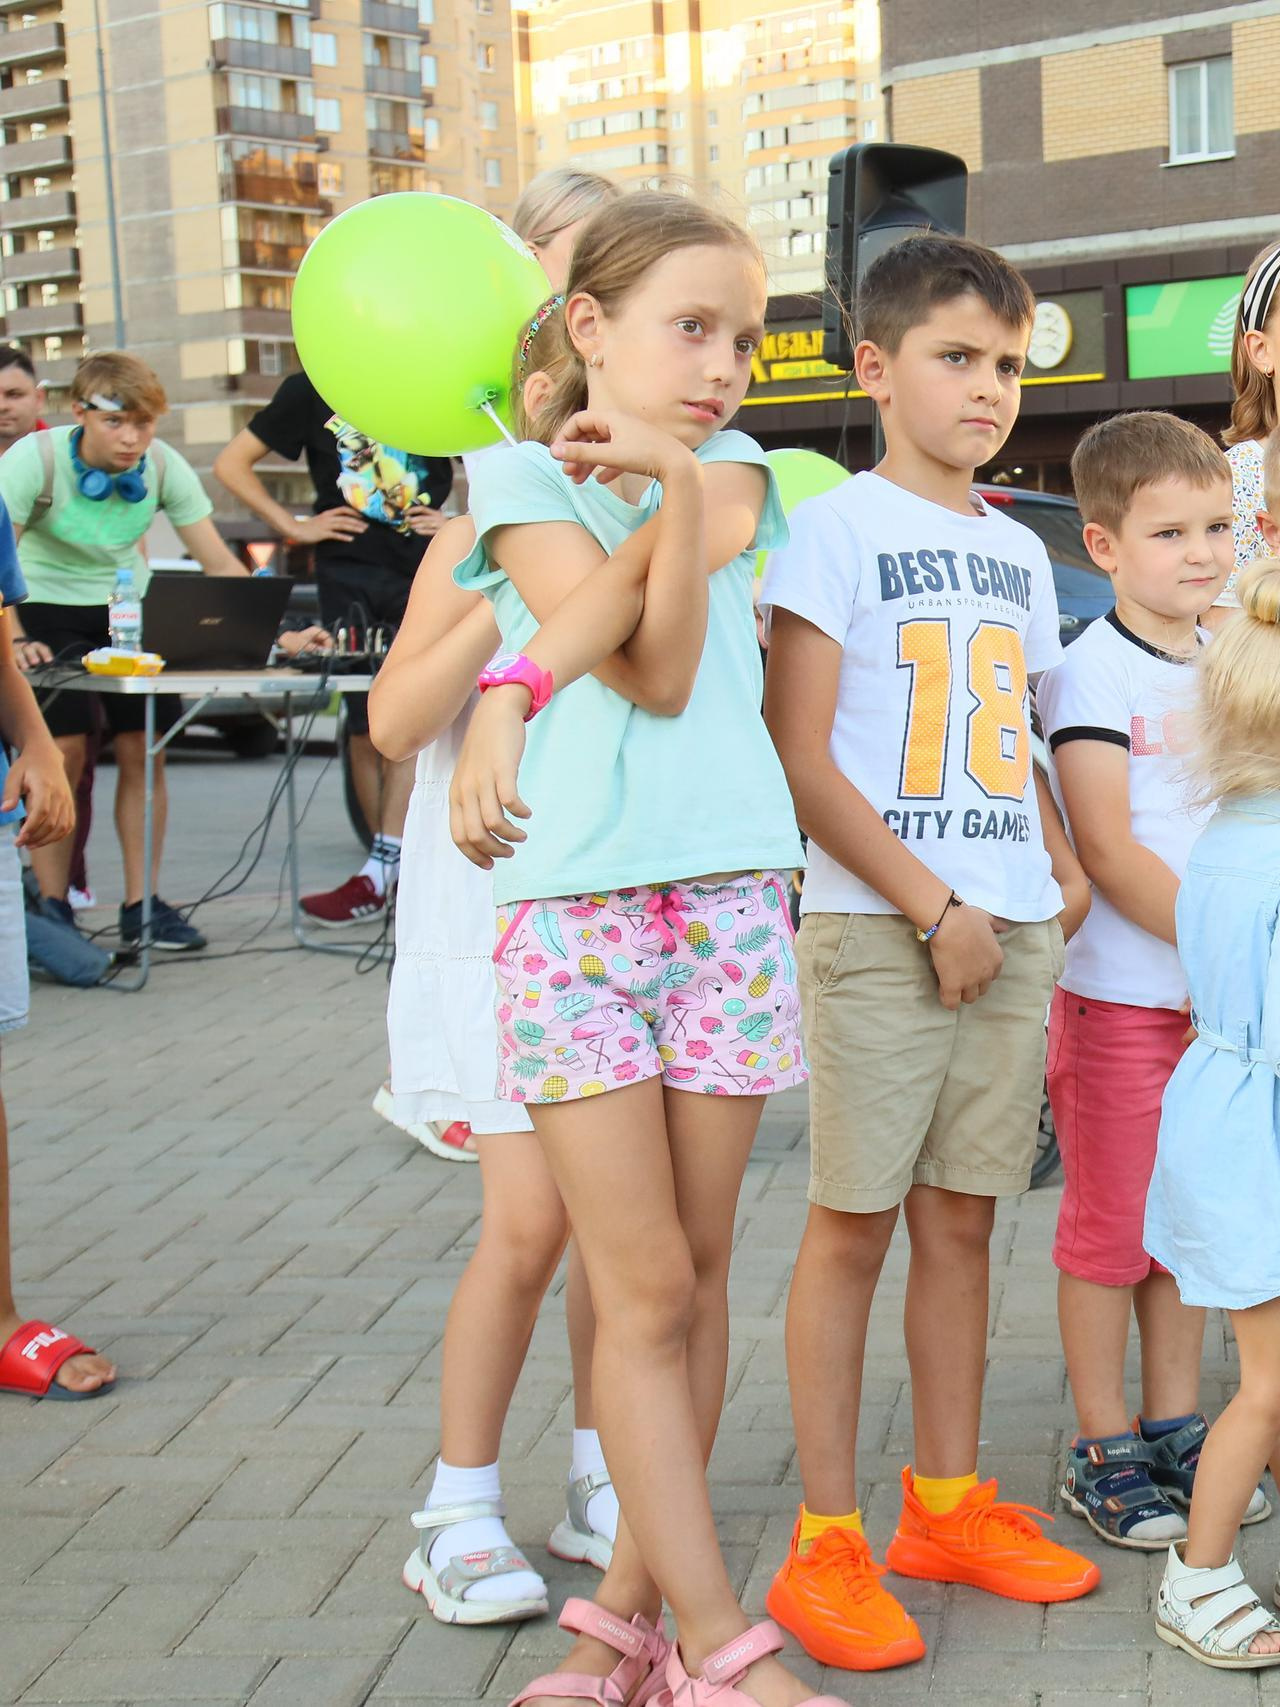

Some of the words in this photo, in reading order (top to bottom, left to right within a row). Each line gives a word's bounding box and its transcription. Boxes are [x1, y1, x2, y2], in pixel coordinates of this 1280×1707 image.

[877, 549, 961, 602] BEST
[966, 552, 1031, 612] CAMP
[908, 598, 952, 609] URBAN
[956, 598, 990, 610] SPORT
[896, 618, 1031, 803] 18
[882, 809, 953, 840] CITY
[962, 809, 1031, 843] GAMES
